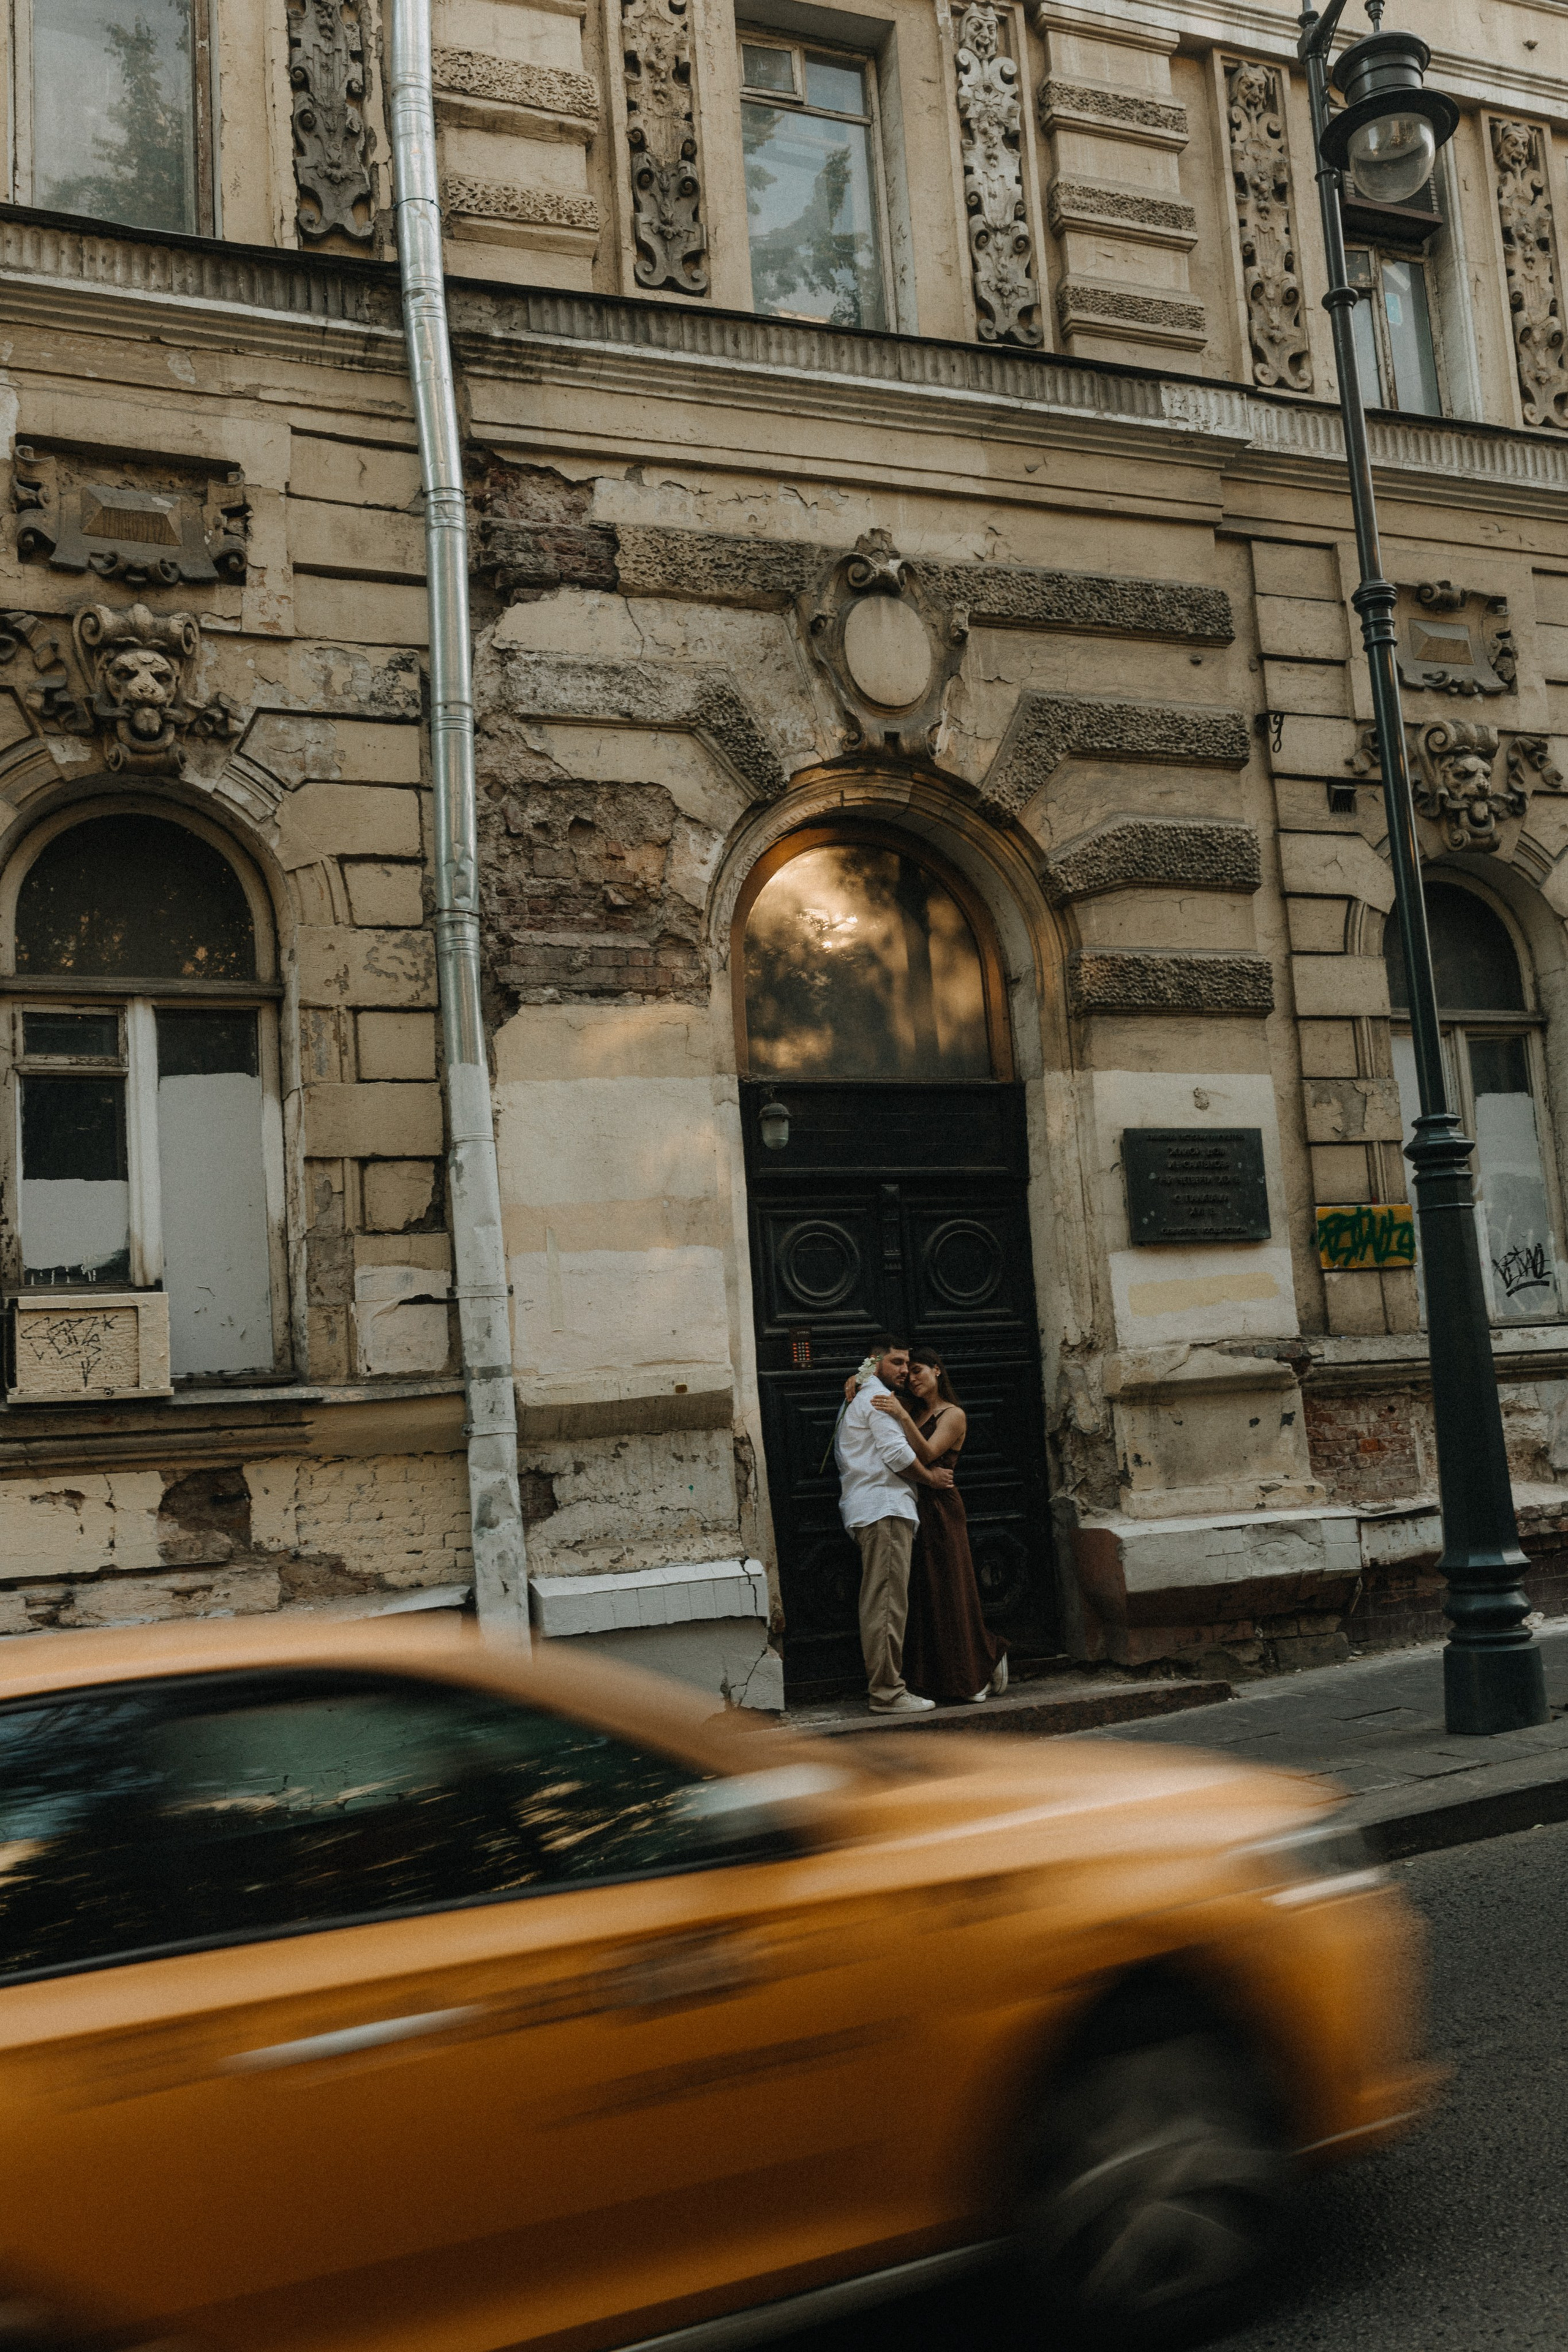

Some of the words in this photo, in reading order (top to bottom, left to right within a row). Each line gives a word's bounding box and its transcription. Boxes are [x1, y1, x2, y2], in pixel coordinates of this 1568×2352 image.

[1167, 1147, 1200, 1157] ЖИЛОЙ
[1207, 1147, 1227, 1157] ДОМ
[1175, 1175, 1212, 1186] ЧЕТВЕРТИ
